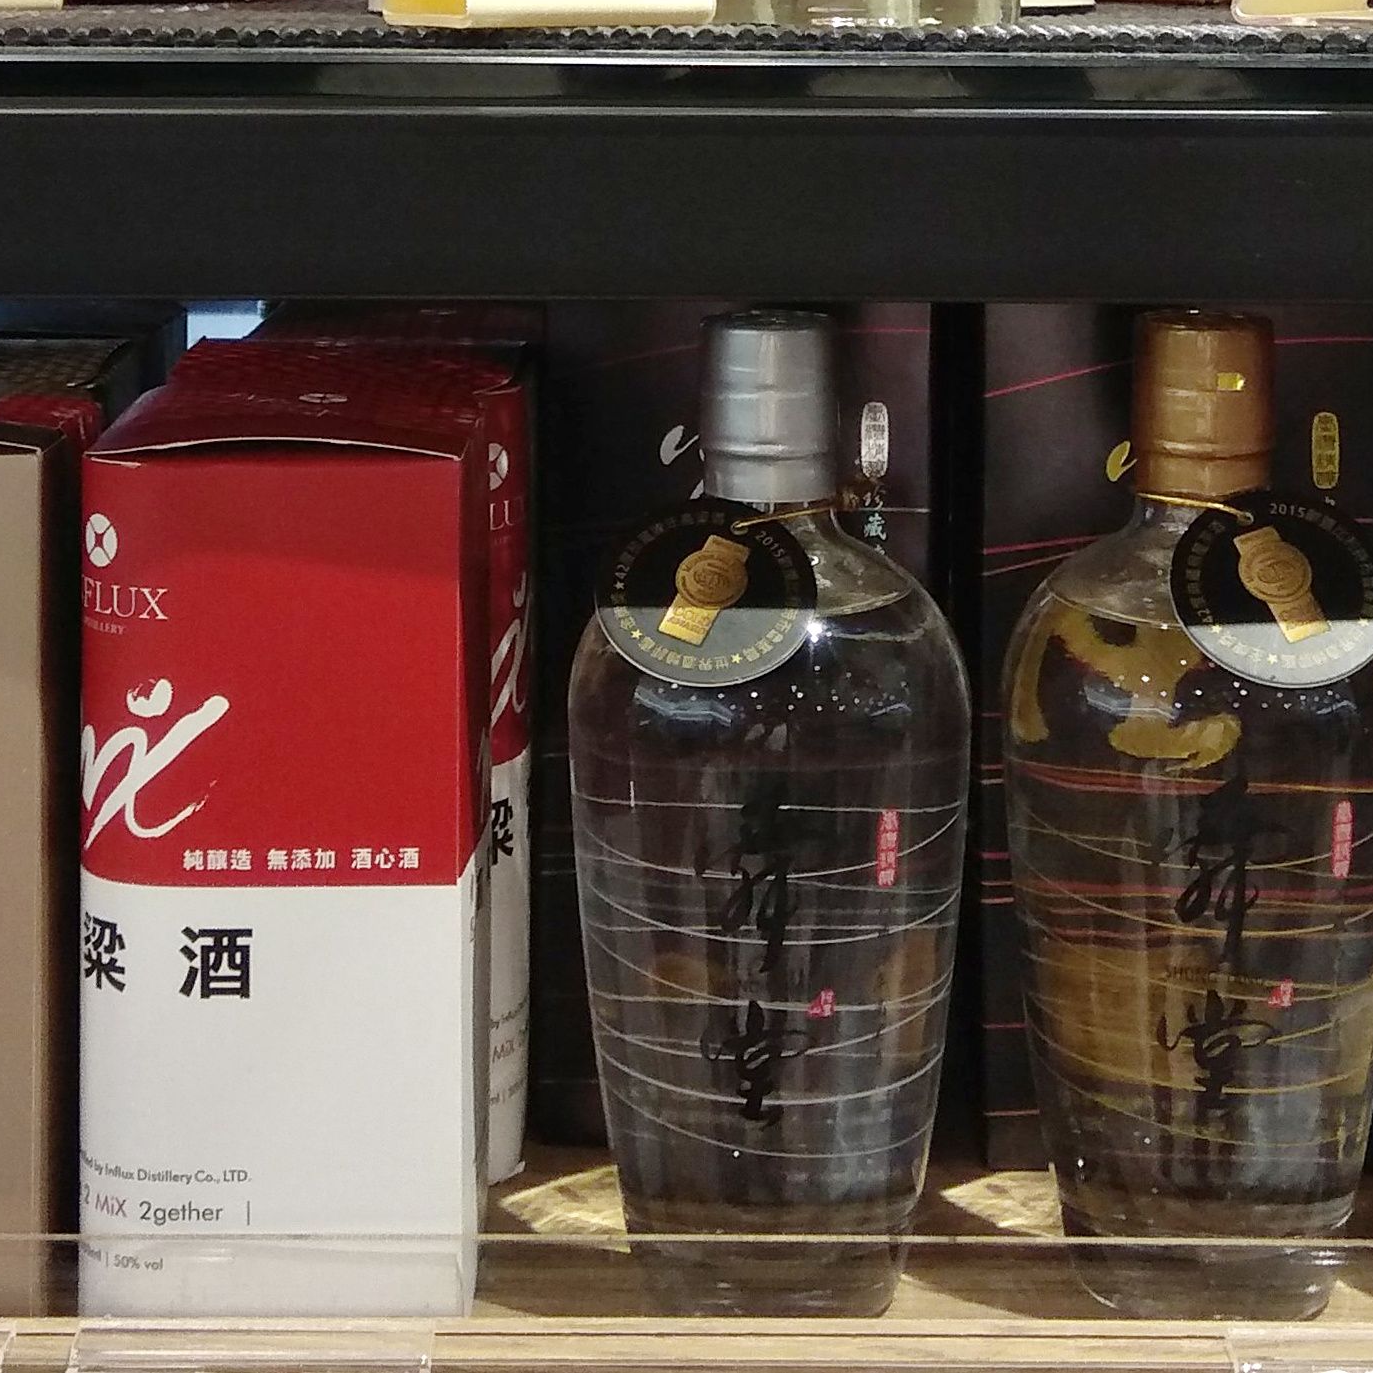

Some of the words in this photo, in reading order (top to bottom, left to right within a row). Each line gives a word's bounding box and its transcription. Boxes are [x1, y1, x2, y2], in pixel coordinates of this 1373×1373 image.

[182, 846, 253, 873] 純釀造
[266, 847, 336, 872] 無添加
[350, 847, 421, 872] 酒心酒
[105, 1163, 134, 1180] Influx
[137, 1168, 193, 1185] Distillery
[95, 1193, 127, 1218] MiX
[139, 1200, 224, 1227] 2gether
[114, 1254, 140, 1270] 50%
[144, 1258, 164, 1271] vol
